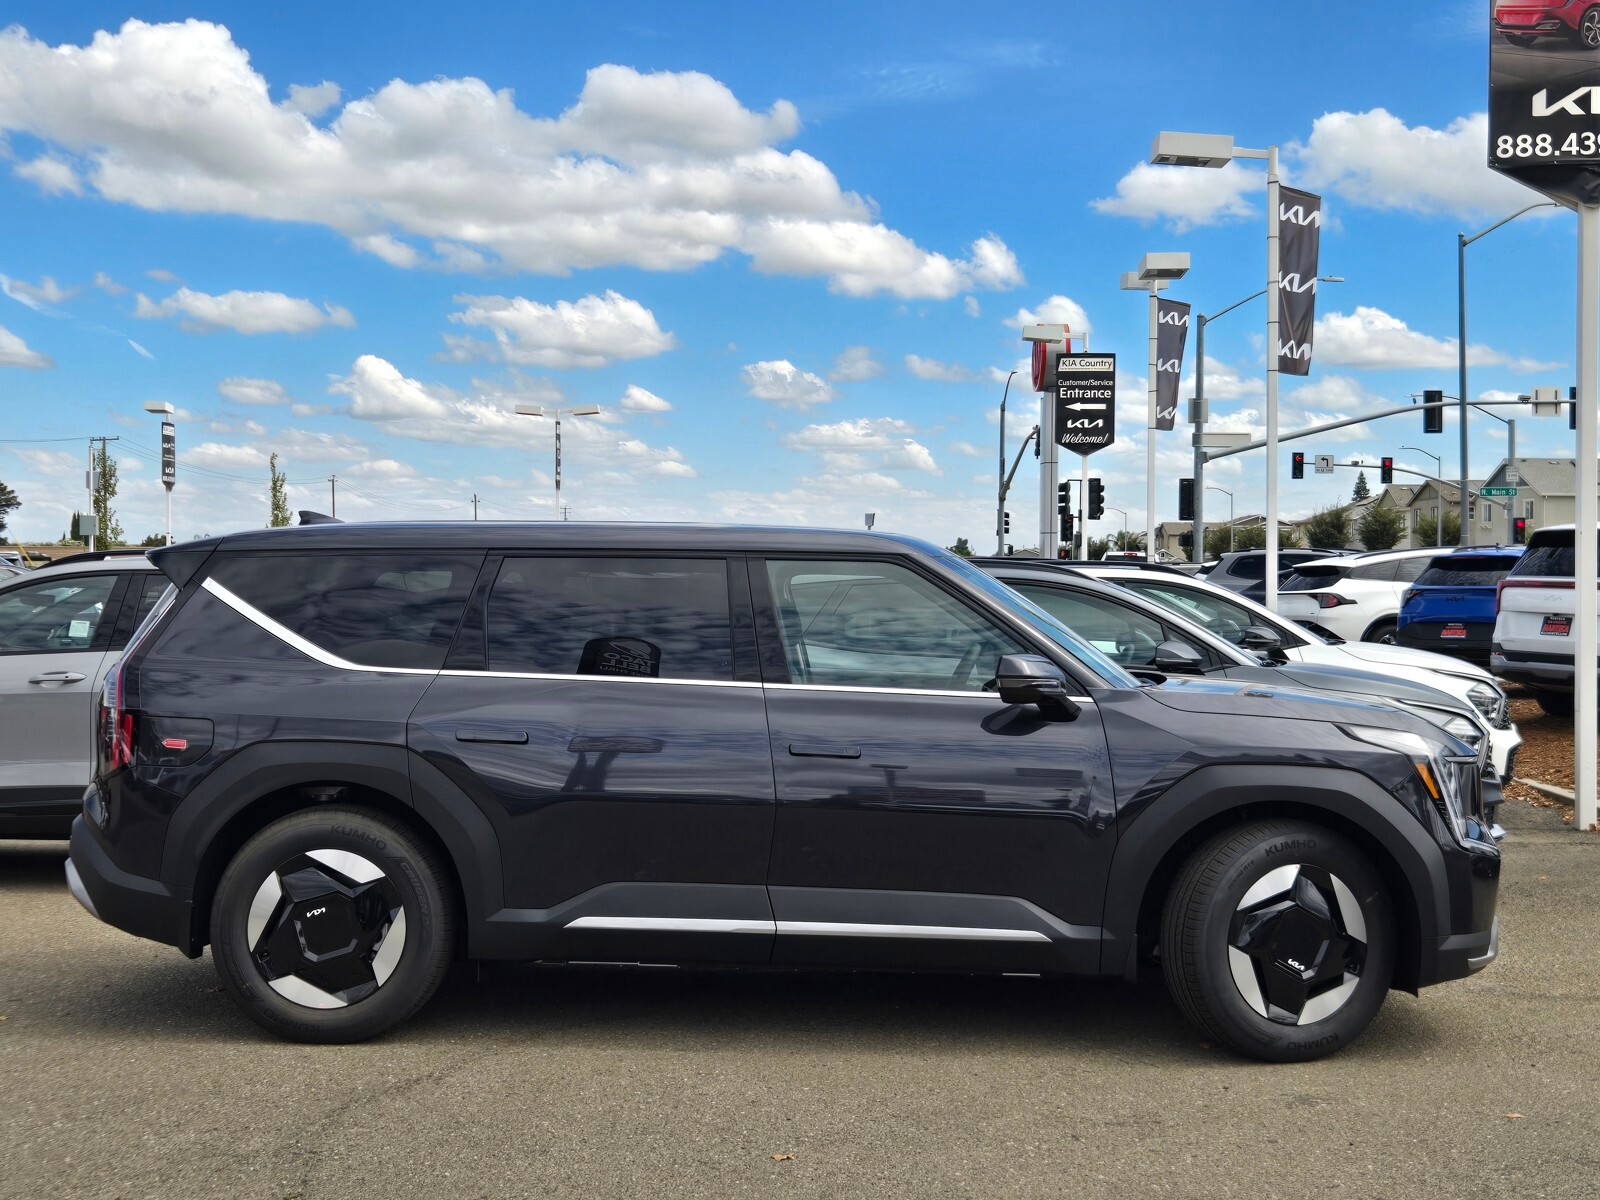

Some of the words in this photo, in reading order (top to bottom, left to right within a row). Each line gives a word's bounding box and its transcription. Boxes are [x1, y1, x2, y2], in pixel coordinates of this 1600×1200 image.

[1532, 86, 1600, 117] KI
[1496, 132, 1600, 158] 888.43
[1279, 202, 1321, 228] KIA
[1061, 359, 1077, 367] KIA
[1079, 359, 1112, 370] Country
[1060, 387, 1111, 398] Entrance
[1067, 418, 1104, 428] KIA
[1061, 432, 1109, 444] Welcome!
[1491, 488, 1506, 496] Main
[1508, 488, 1516, 496] St
[329, 824, 388, 850] KUMHO
[1264, 839, 1317, 857] KUMHO
[306, 906, 326, 918] KIA
[1287, 958, 1306, 971] KIA
